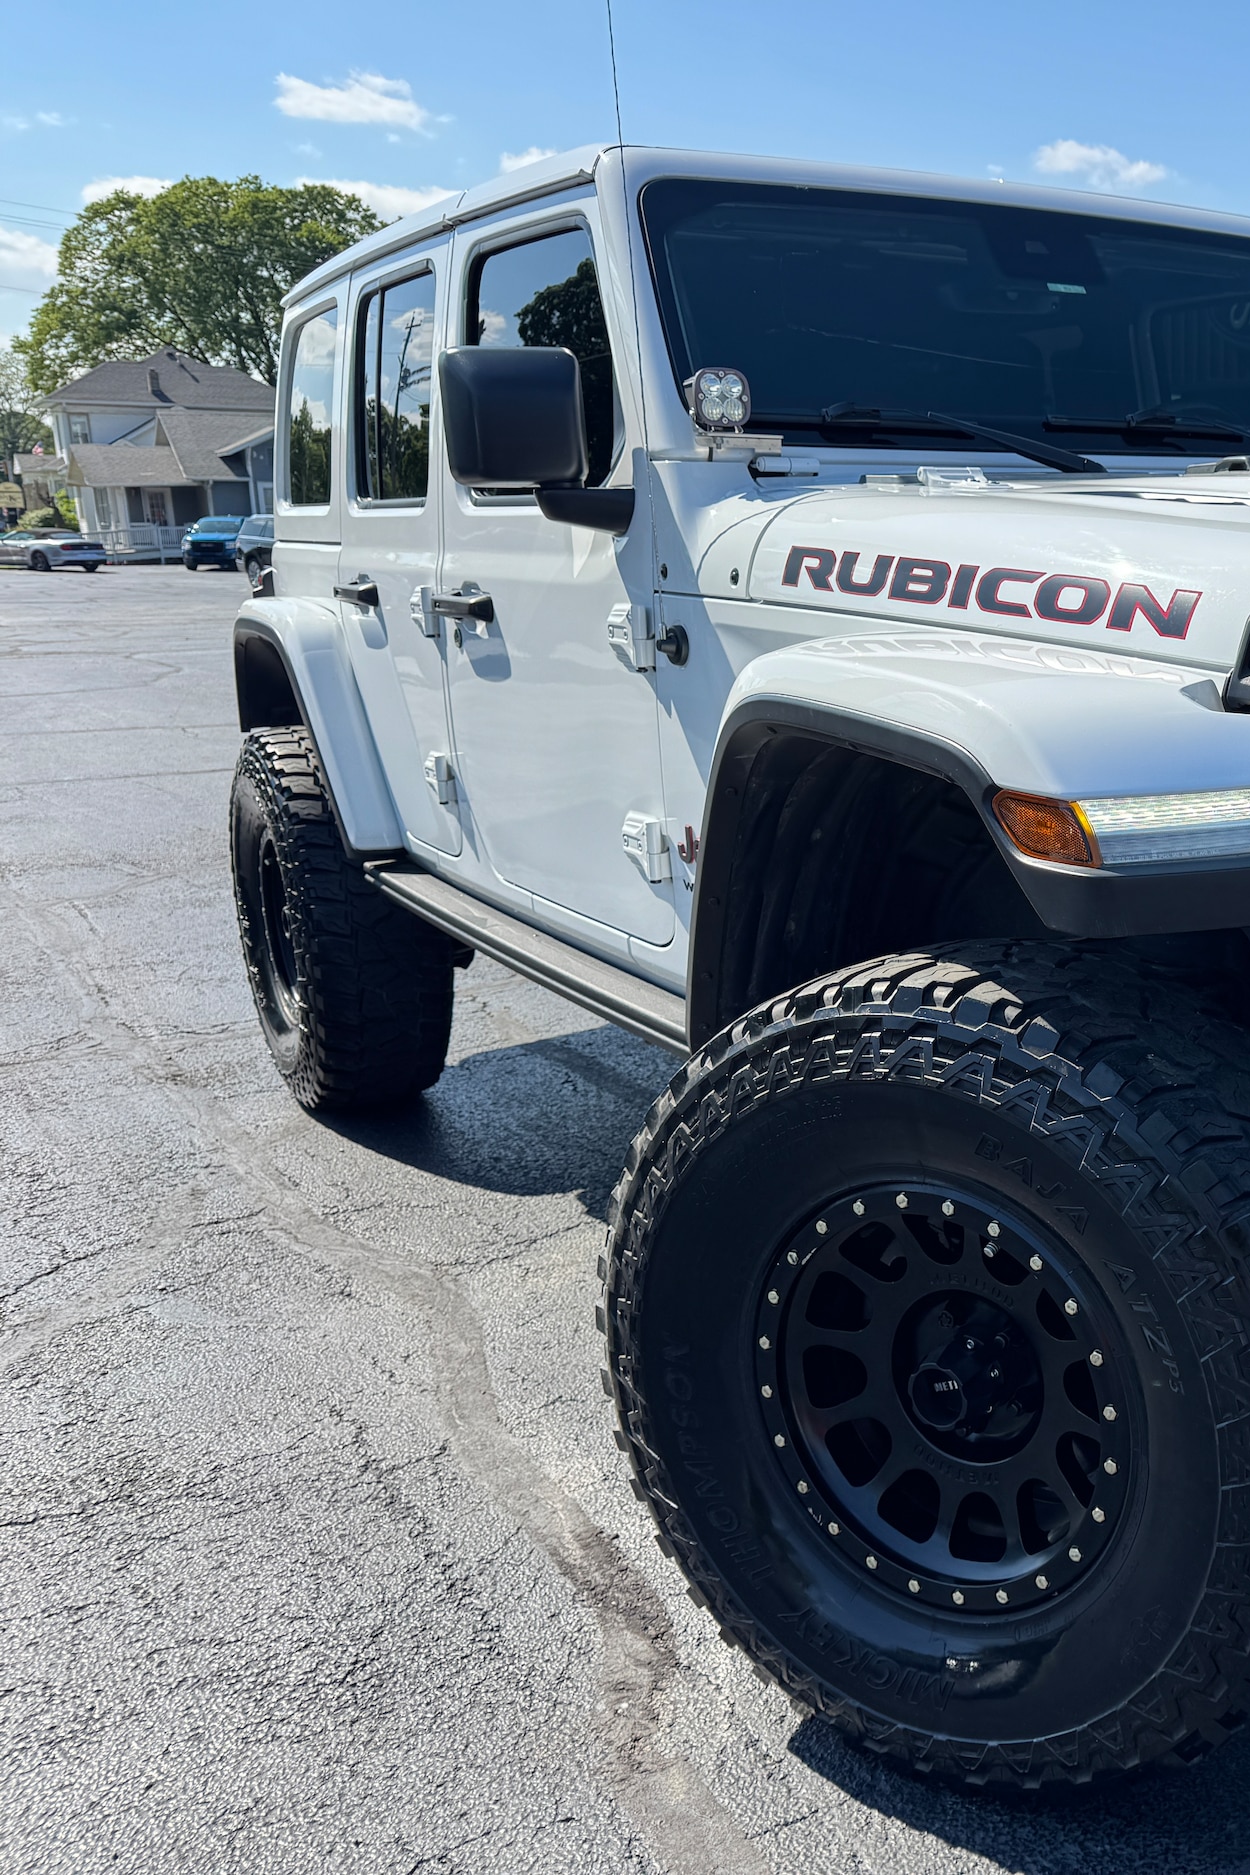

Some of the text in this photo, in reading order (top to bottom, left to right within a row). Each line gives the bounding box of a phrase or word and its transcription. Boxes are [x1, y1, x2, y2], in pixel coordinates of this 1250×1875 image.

[781, 545, 1203, 640] RUBICON
[974, 1132, 1090, 1236] BAJA
[662, 1330, 775, 1590] THOMPSON
[778, 1605, 956, 1711] MICKEY
